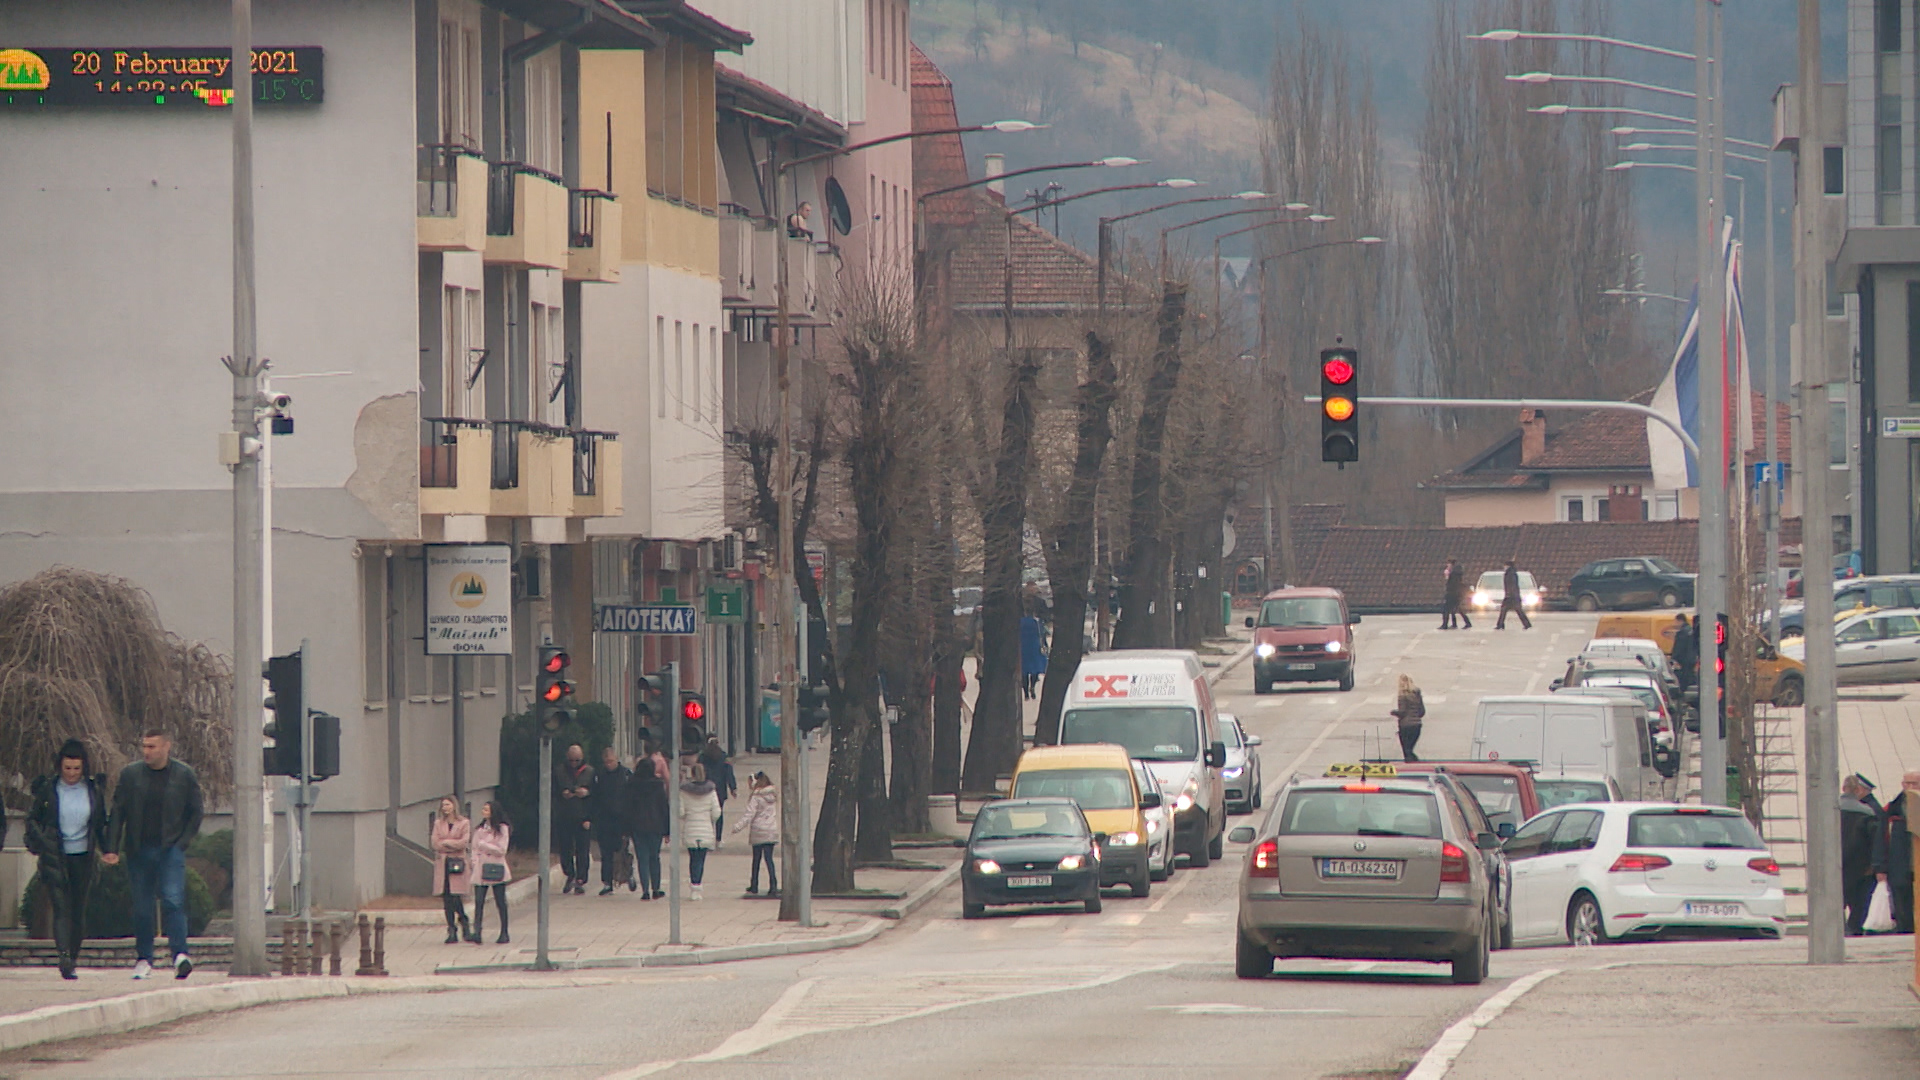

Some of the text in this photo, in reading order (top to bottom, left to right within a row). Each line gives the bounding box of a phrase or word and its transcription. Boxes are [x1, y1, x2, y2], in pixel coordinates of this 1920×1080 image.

[72, 51, 101, 75] 20
[114, 51, 231, 77] February
[602, 607, 685, 631] АПОТЕКА
[453, 643, 485, 652] ФОЧА
[1330, 765, 1394, 774] TAXI
